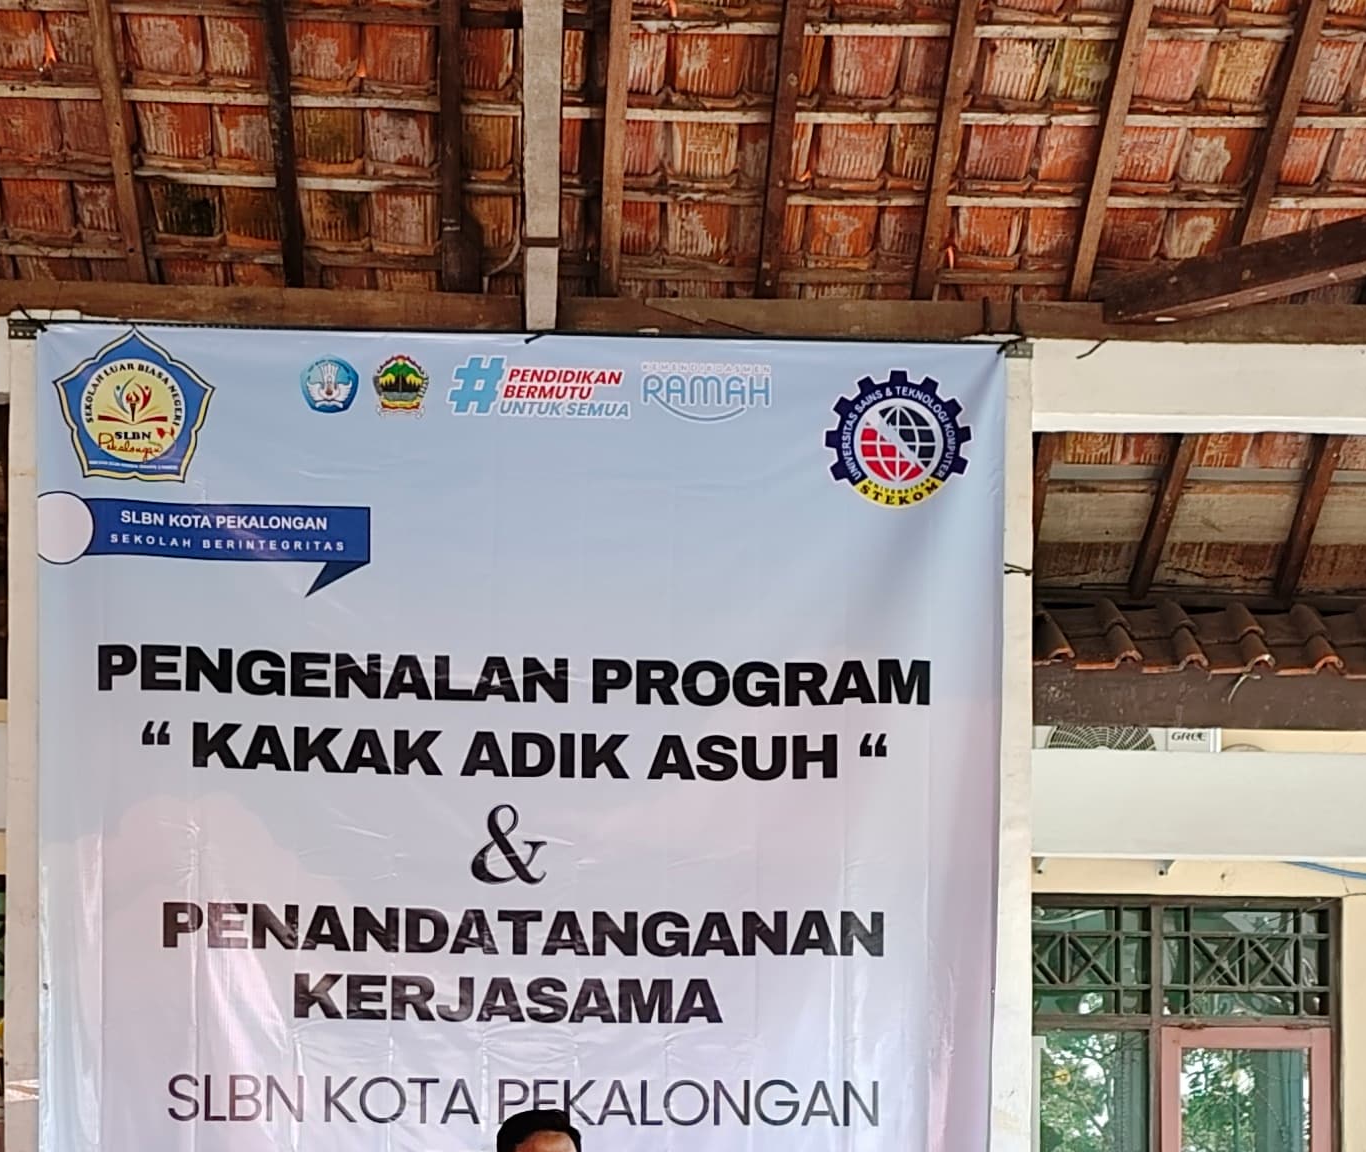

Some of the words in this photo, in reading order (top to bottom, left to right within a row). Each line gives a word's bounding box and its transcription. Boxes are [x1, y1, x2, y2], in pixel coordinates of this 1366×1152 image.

[85, 373, 104, 424] SEKOLAH
[103, 363, 135, 377] LUAR
[137, 363, 169, 385] BIASA
[169, 385, 183, 426] NEGERI
[503, 385, 592, 400] BERMUTU
[508, 368, 622, 385] PENDIDIKAN
[643, 374, 770, 406] RAMAH
[499, 401, 565, 416] UNTUK
[567, 402, 630, 418] SEMUA
[115, 431, 151, 441] SLBN
[841, 413, 862, 480] UNIVERSITAS
[854, 390, 883, 413] SAINS
[895, 386, 949, 423] TEKNOLOGI
[936, 423, 956, 478] KOMPUTER
[860, 482, 938, 505] STEKOM
[121, 510, 164, 526] SLBN
[169, 513, 212, 529] KOTA
[216, 515, 328, 531] PEKALONGAN
[111, 533, 191, 548] SEKOLAH
[202, 539, 345, 552] BERINTEGRITAS
[98, 644, 568, 703] PENGENALAN
[593, 659, 930, 707] PROGRAM
[193, 722, 442, 776] KAKAK
[460, 731, 629, 779] ADIK
[647, 734, 837, 781] ASUH
[471, 805, 546, 884] &
[163, 902, 884, 957] PENANDATANGANAN
[294, 974, 723, 1023] KERJASAMA
[168, 1074, 303, 1123] SLBN
[325, 1076, 480, 1125] KOTA
[498, 1079, 878, 1127] PEKALONGAN
